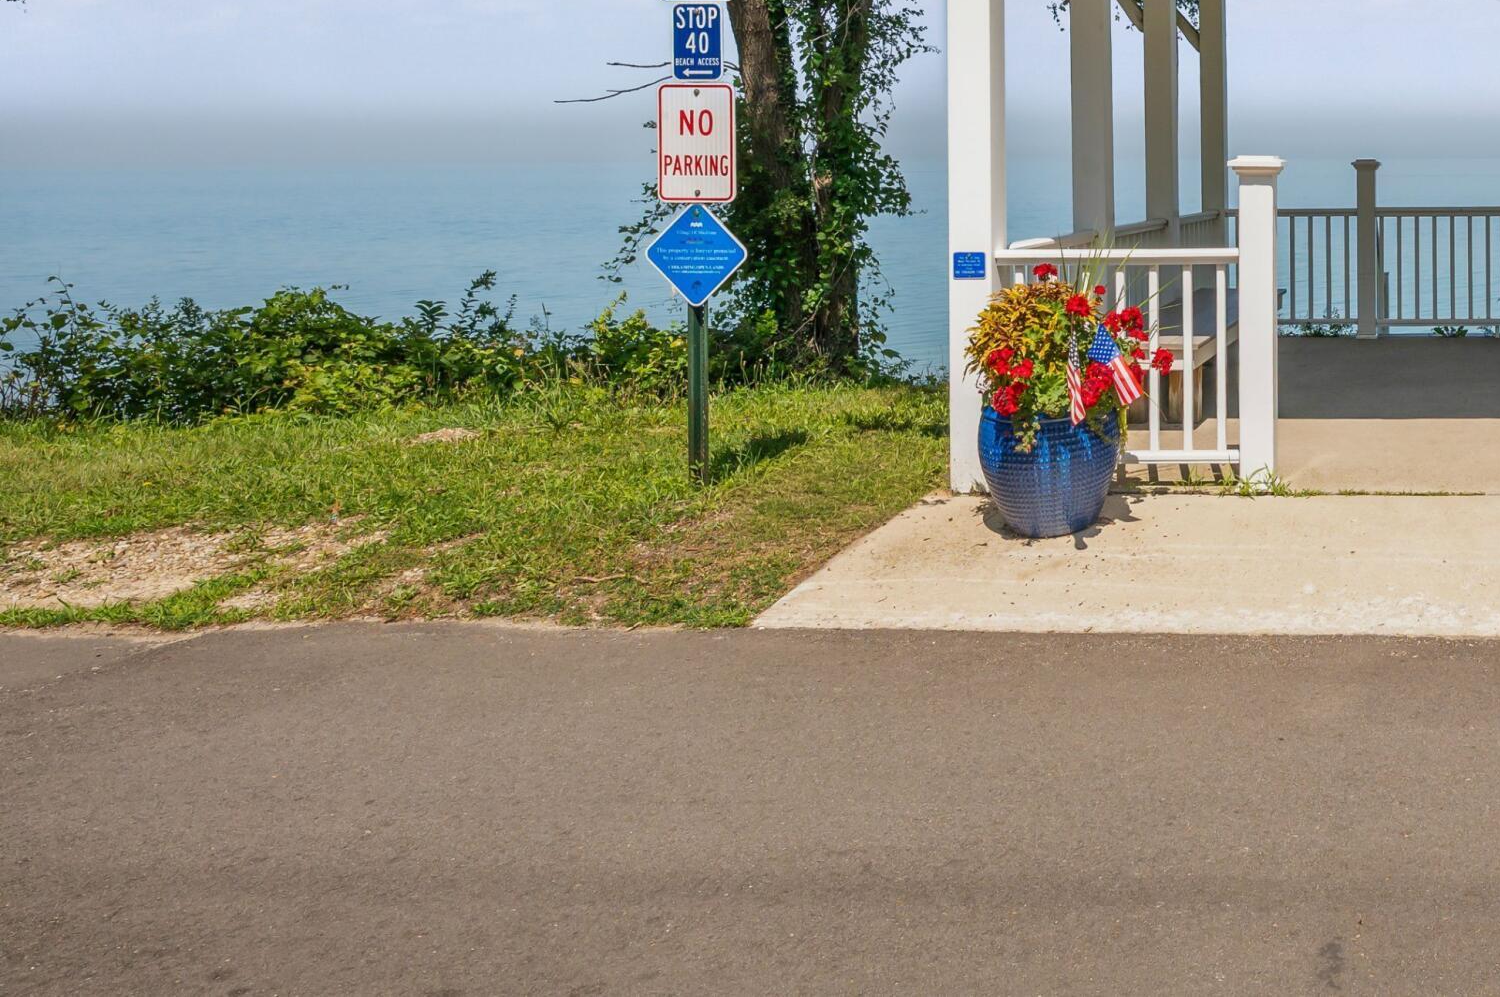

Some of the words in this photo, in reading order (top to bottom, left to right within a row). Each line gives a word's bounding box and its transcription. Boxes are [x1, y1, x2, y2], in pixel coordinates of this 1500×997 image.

[676, 6, 718, 29] STOP
[685, 31, 709, 54] 40
[675, 57, 695, 66] BEACH
[697, 57, 720, 66] ACCESS
[679, 109, 714, 136] NO
[663, 154, 729, 177] PARKING
